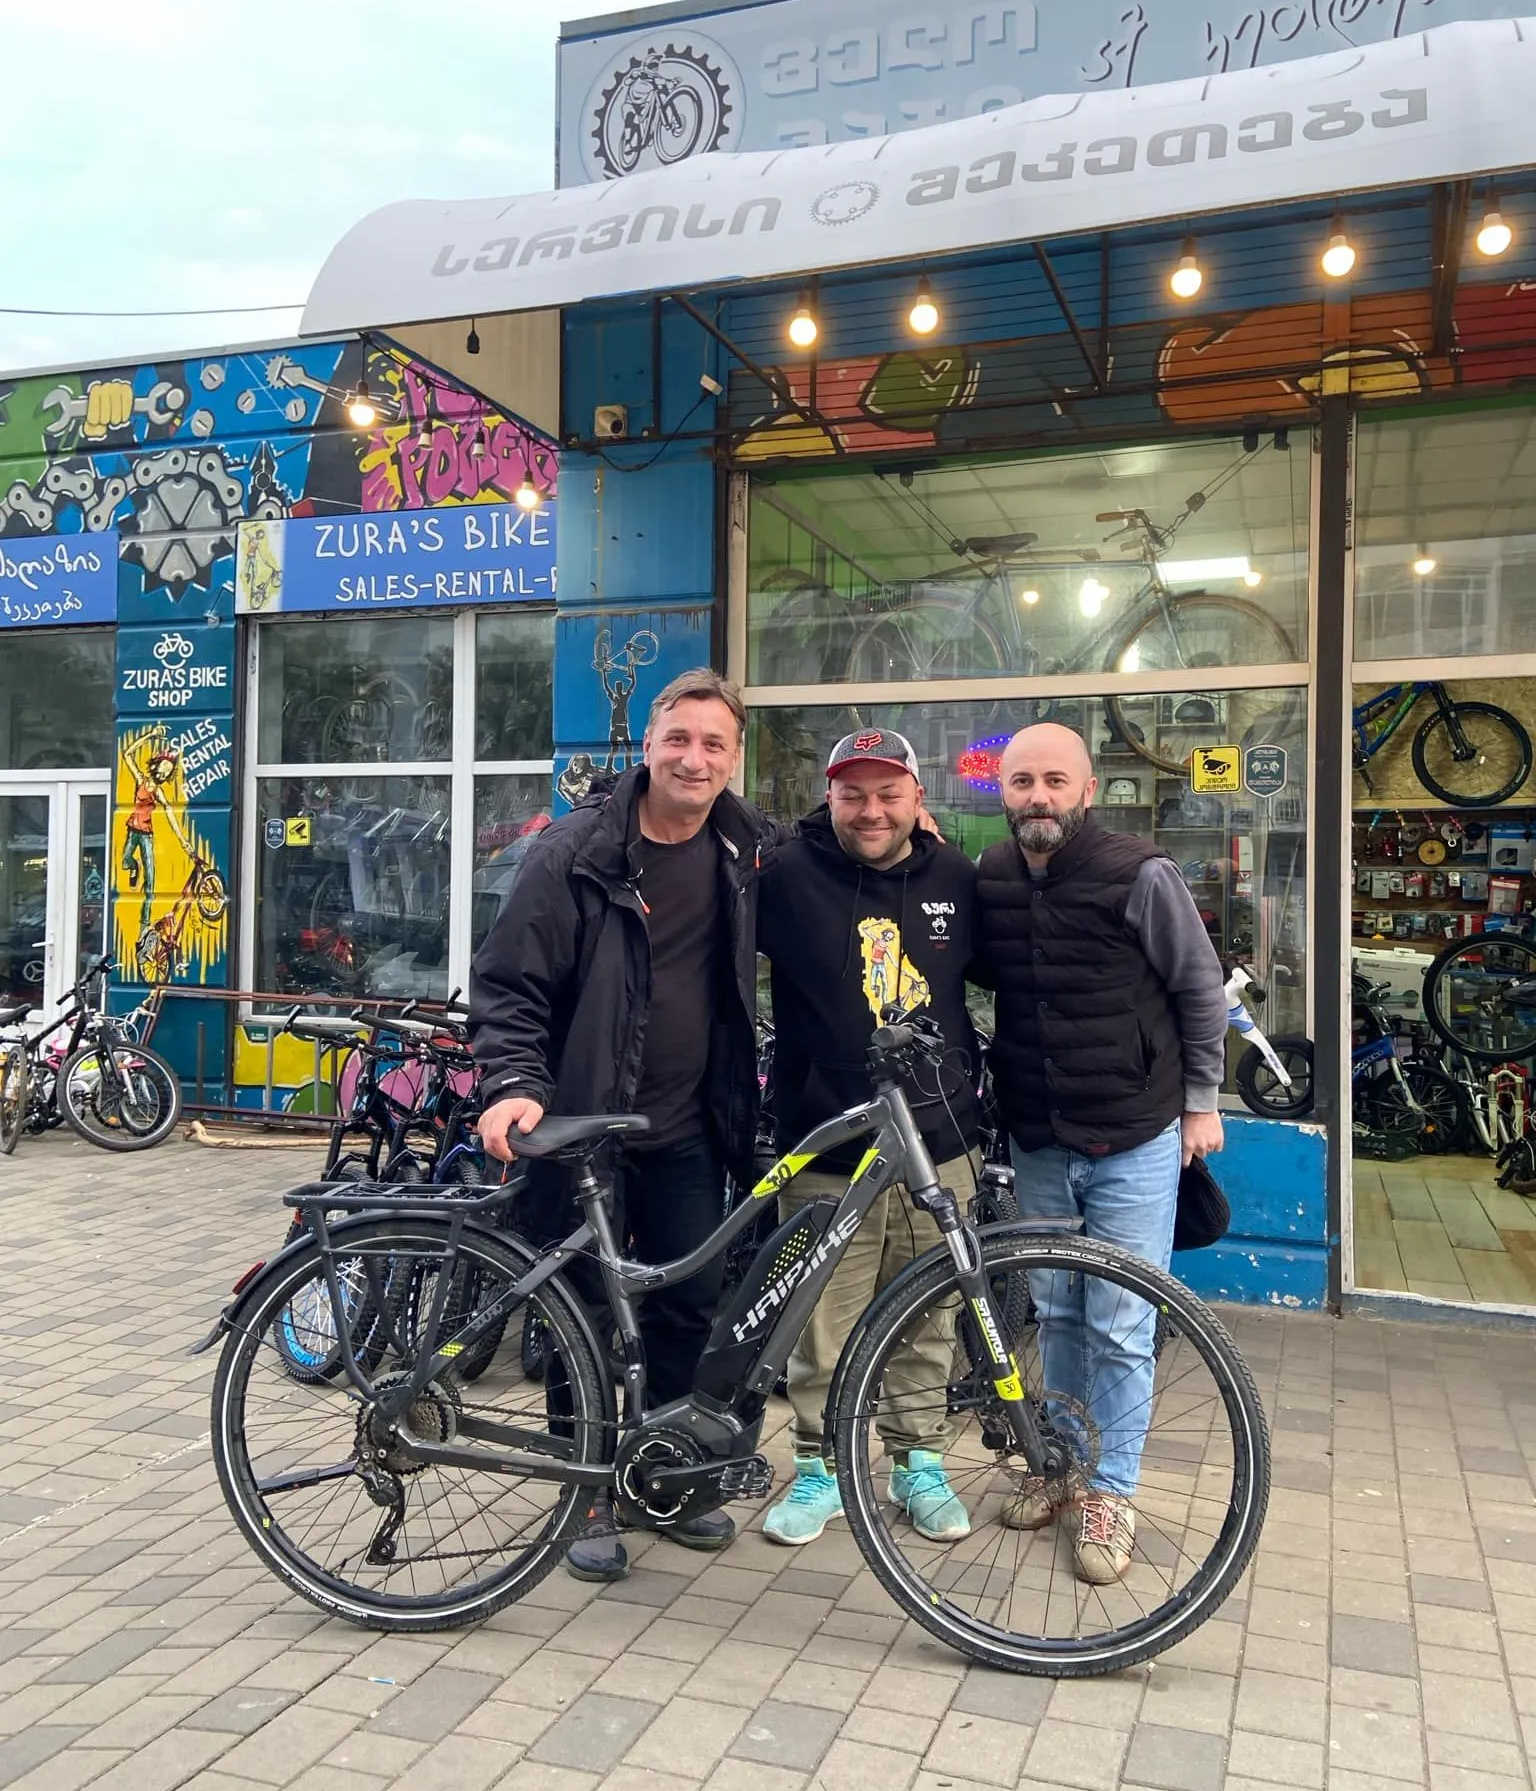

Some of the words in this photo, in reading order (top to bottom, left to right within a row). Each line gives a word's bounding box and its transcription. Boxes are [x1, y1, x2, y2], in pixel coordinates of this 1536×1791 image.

[431, 197, 782, 277] სერვისი
[906, 88, 1428, 206] შეკეთება
[314, 518, 444, 558] ZURA'S
[464, 510, 550, 550] BIKE
[0, 543, 101, 590] აღაზია
[123, 668, 186, 689] ZURA'S
[189, 666, 227, 687] BIKE
[148, 690, 192, 707] SHOP
[169, 718, 217, 756] SALES
[181, 734, 232, 774] RENTAL
[181, 759, 231, 800] REPAIR
